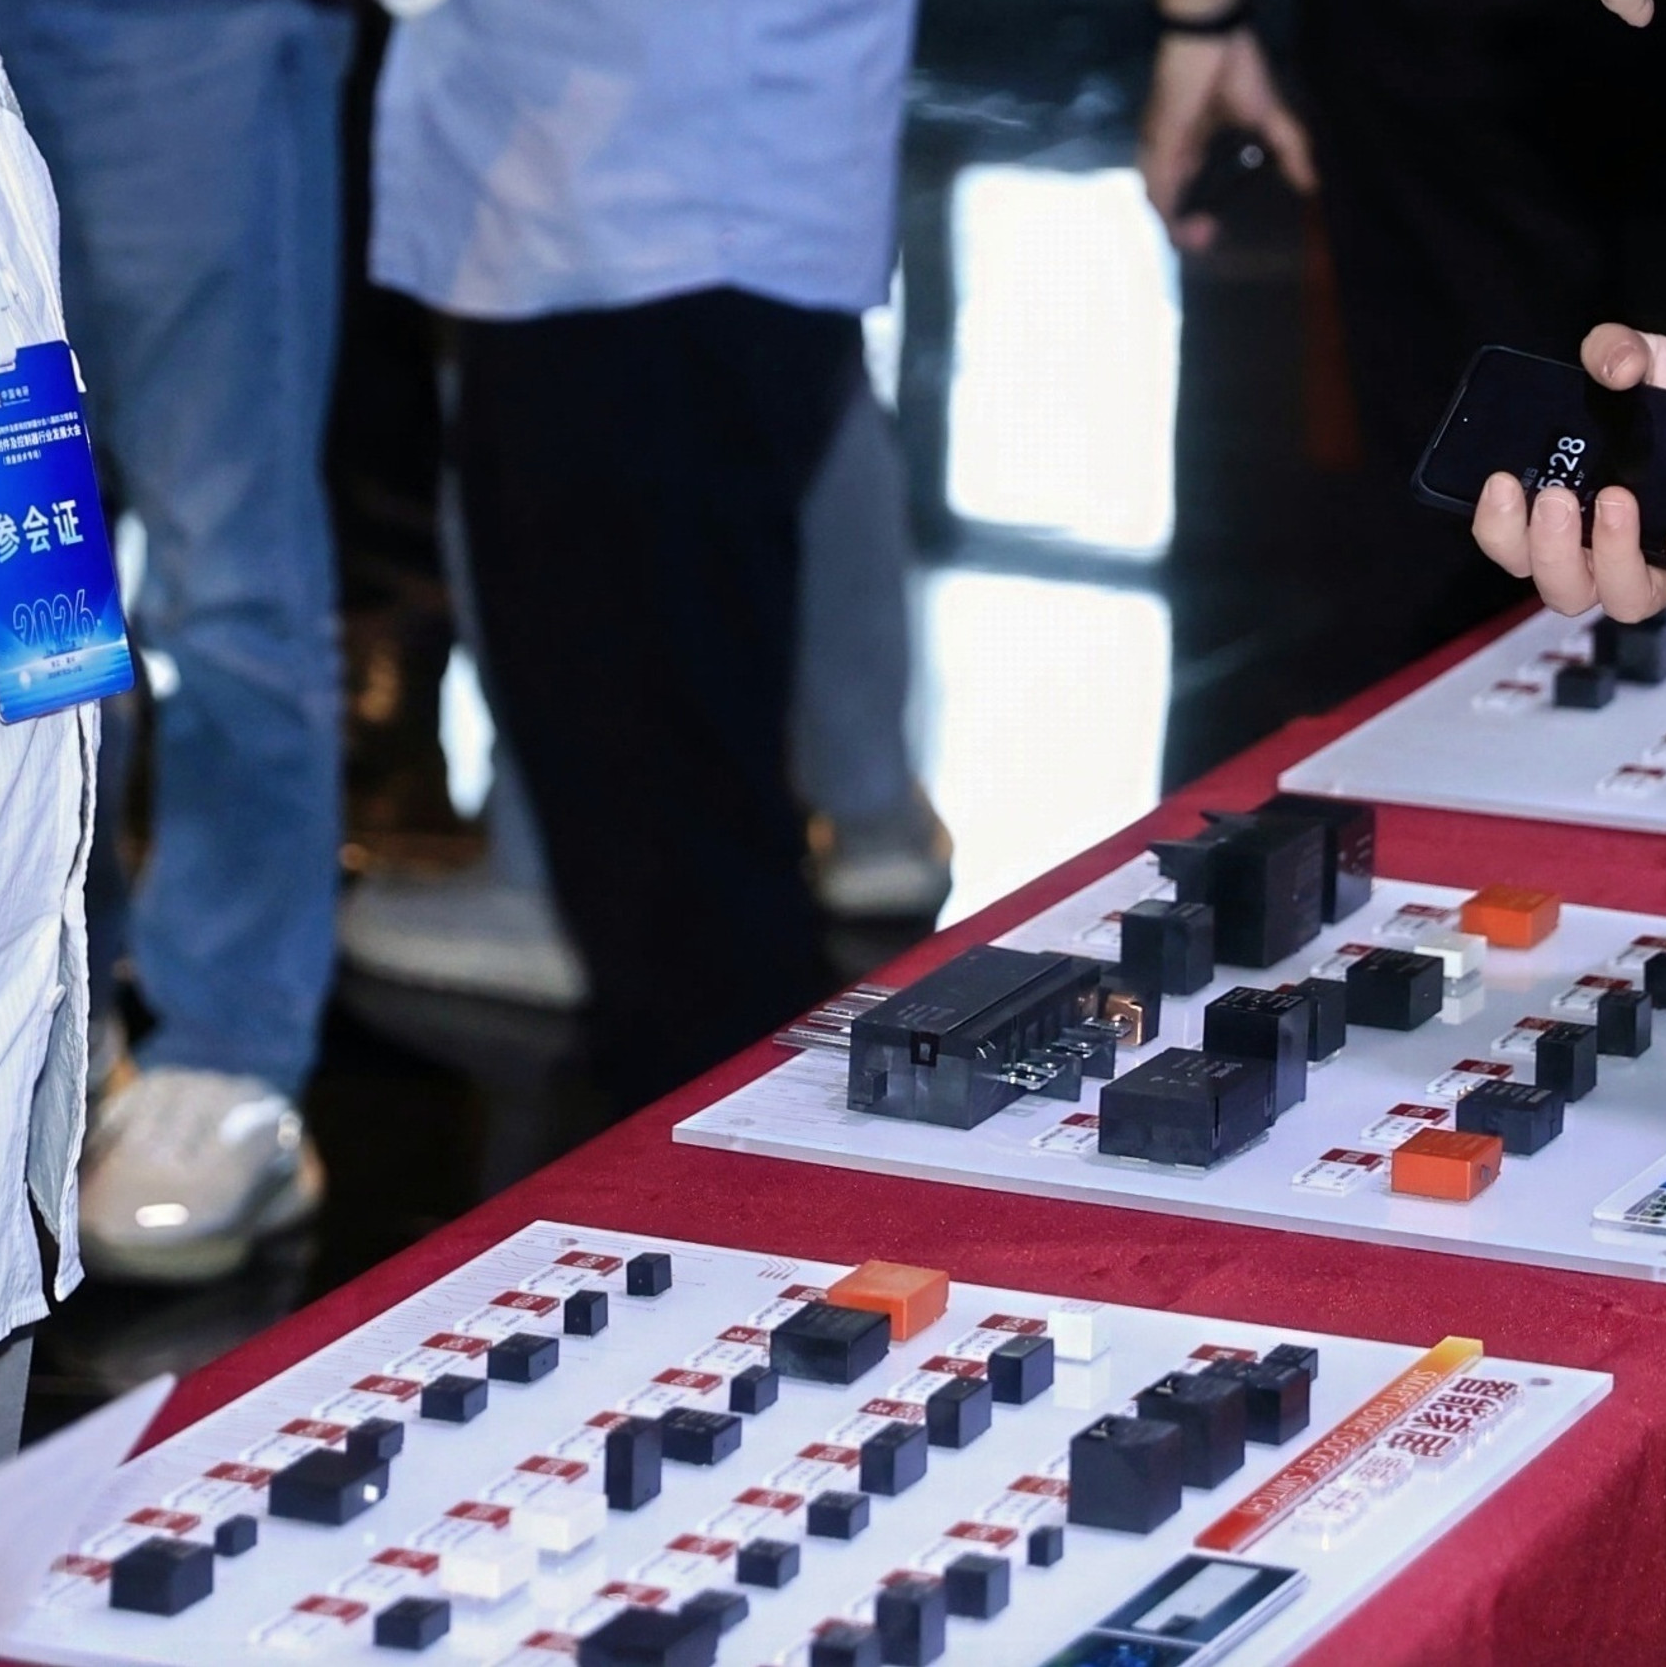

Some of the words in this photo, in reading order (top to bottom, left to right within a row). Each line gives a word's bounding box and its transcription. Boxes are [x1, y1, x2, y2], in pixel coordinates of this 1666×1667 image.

[12, 588, 97, 647] 2026
[1383, 1368, 1438, 1404] SMART
[1343, 1399, 1395, 1434] HOME
[1386, 1376, 1519, 1458] 智能家居
